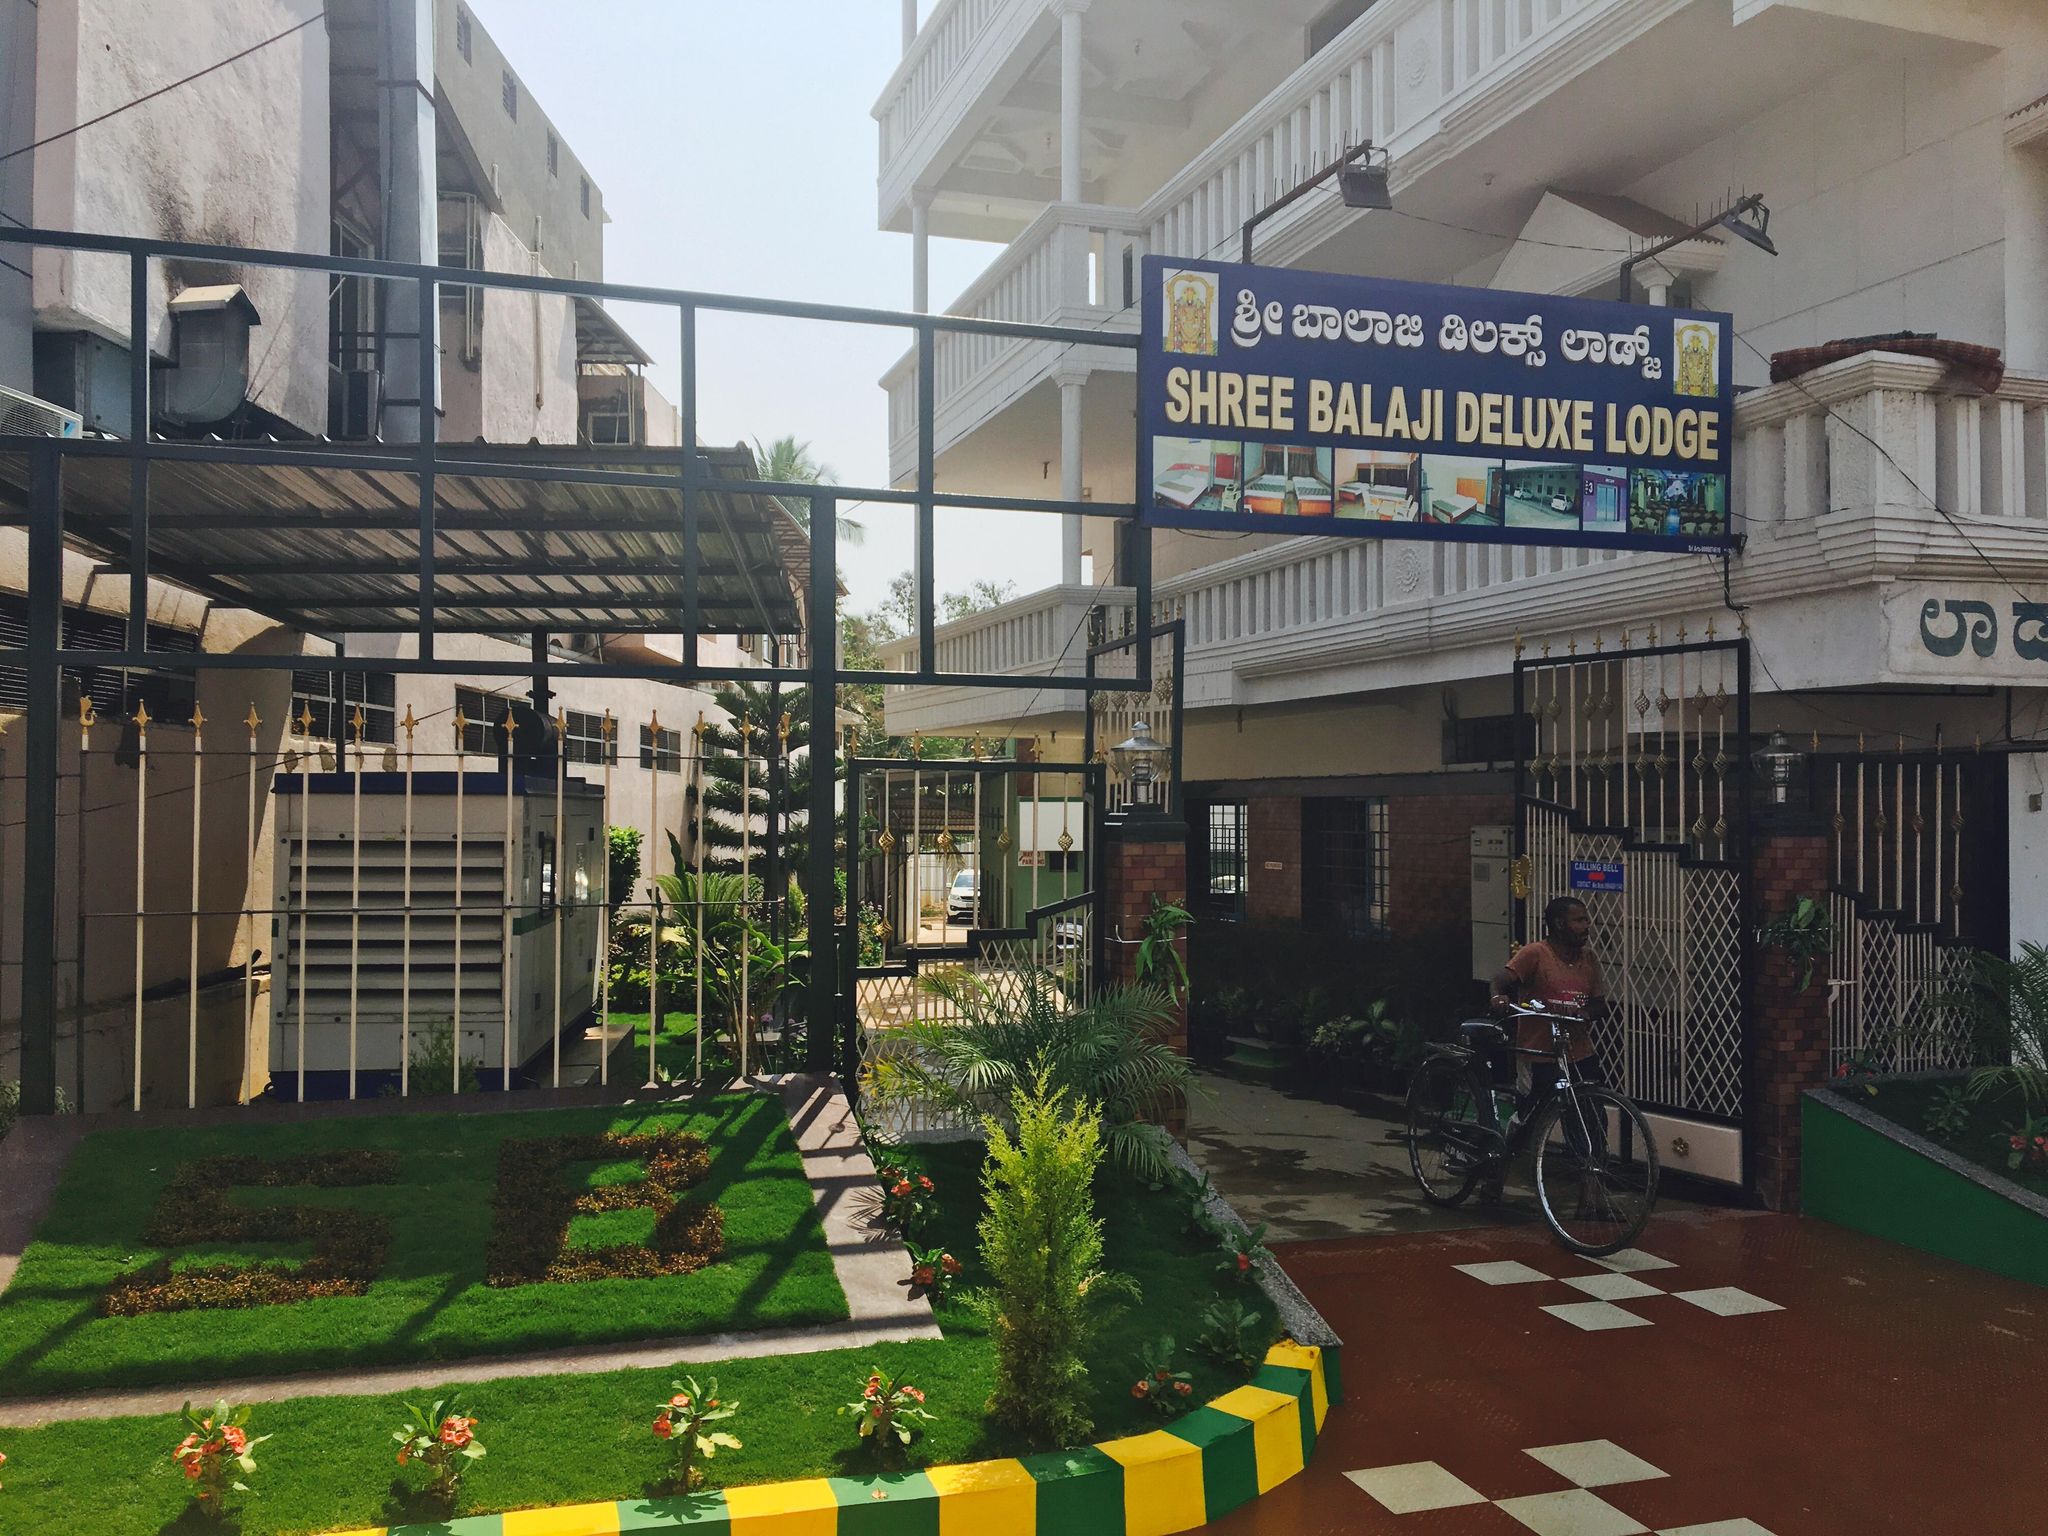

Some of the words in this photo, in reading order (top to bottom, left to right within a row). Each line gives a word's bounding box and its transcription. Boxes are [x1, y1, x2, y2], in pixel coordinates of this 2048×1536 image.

[1230, 288, 1284, 348] ಶ್ರೀ
[1291, 304, 1425, 348] ಬಾಲಾಜಿ
[1165, 366, 1294, 431] SHREE
[1308, 379, 1444, 441] BALAJI
[1456, 391, 1594, 451] DELUXE
[1605, 402, 1719, 461] LODGE
[1574, 862, 1602, 871] CALLING
[1603, 864, 1619, 873] BELL
